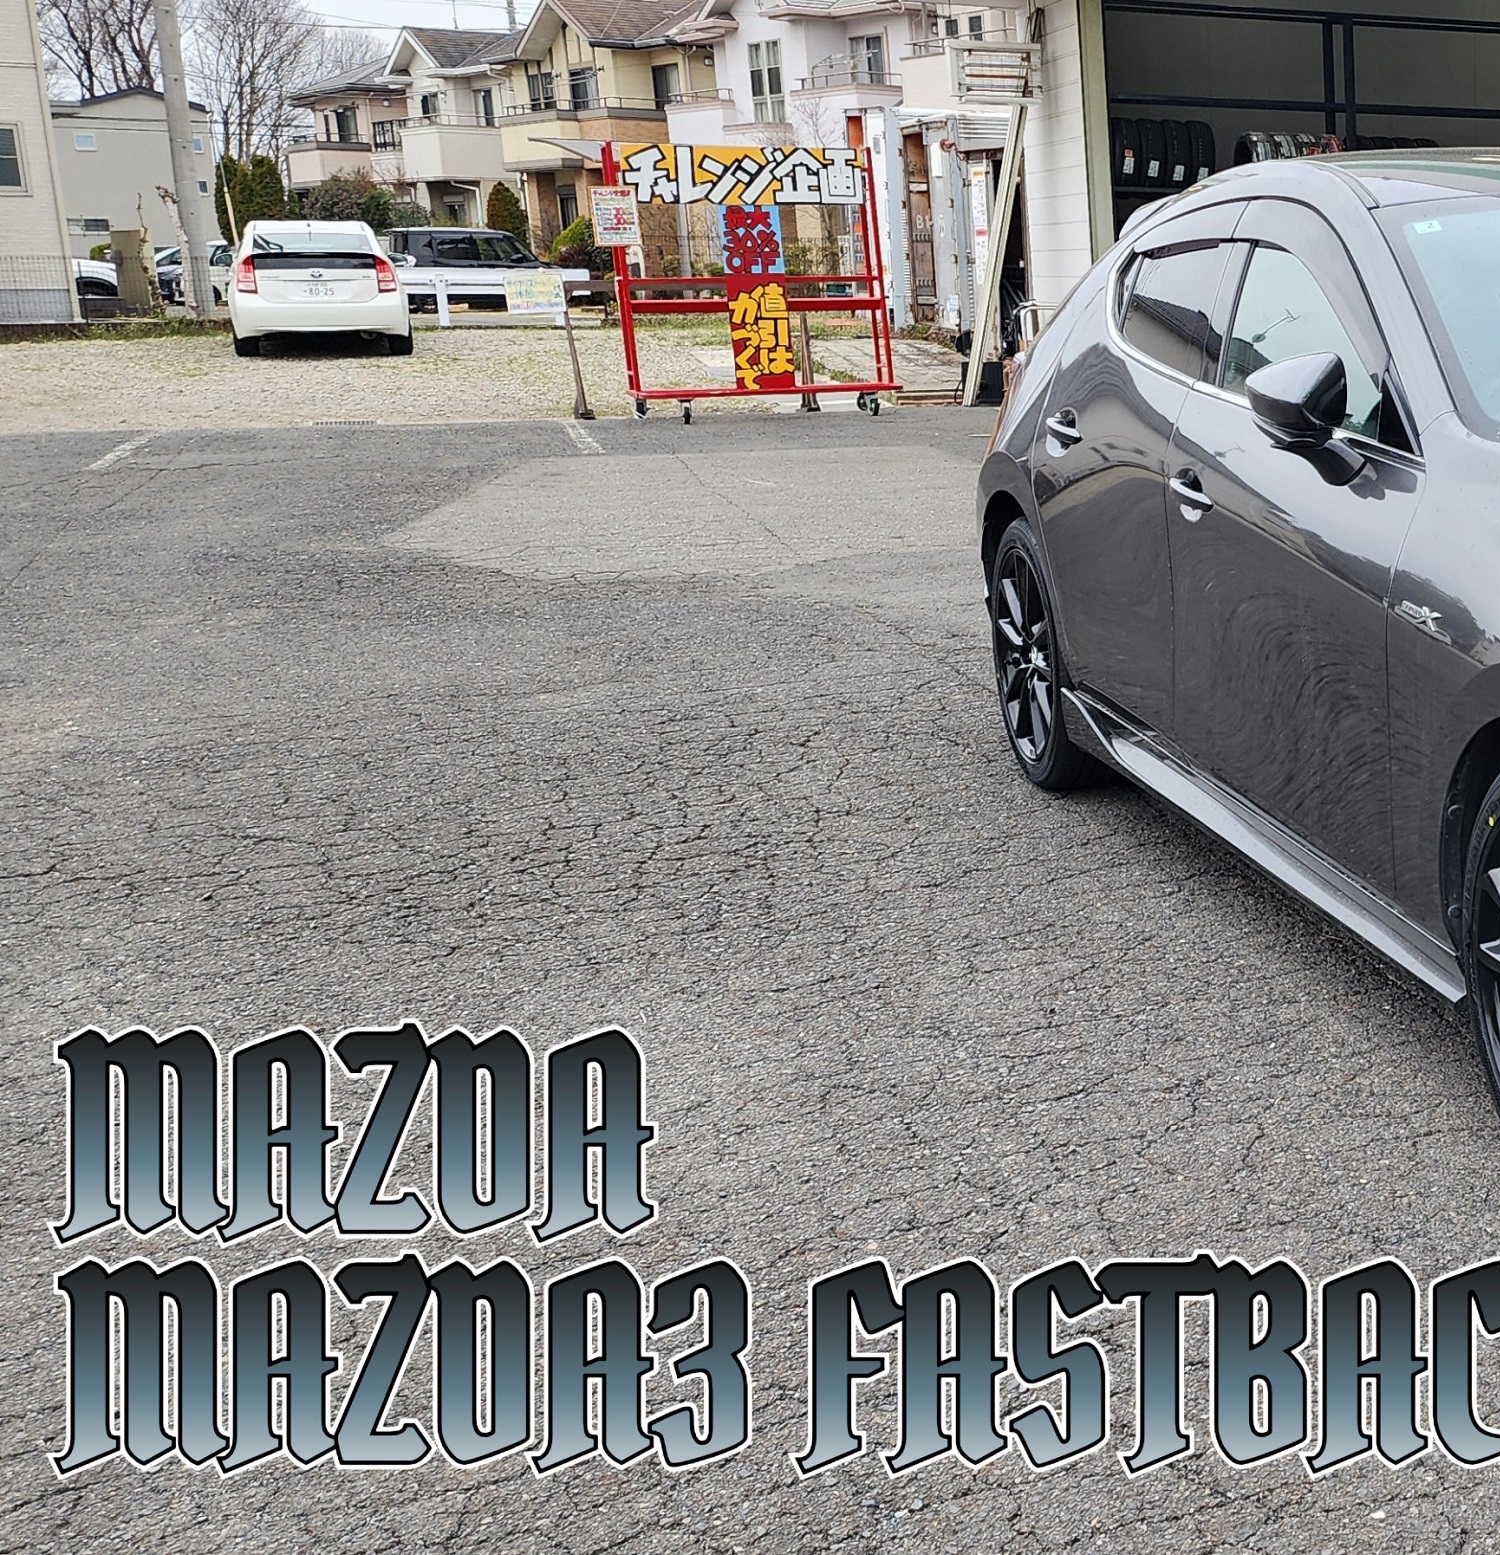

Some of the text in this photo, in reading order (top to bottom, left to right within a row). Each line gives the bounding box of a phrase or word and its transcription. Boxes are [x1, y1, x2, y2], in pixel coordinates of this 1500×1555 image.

[622, 145, 866, 205] チャレンジ企画
[723, 206, 773, 230] 最大
[723, 229, 780, 254] 30%
[725, 251, 781, 275] OFF
